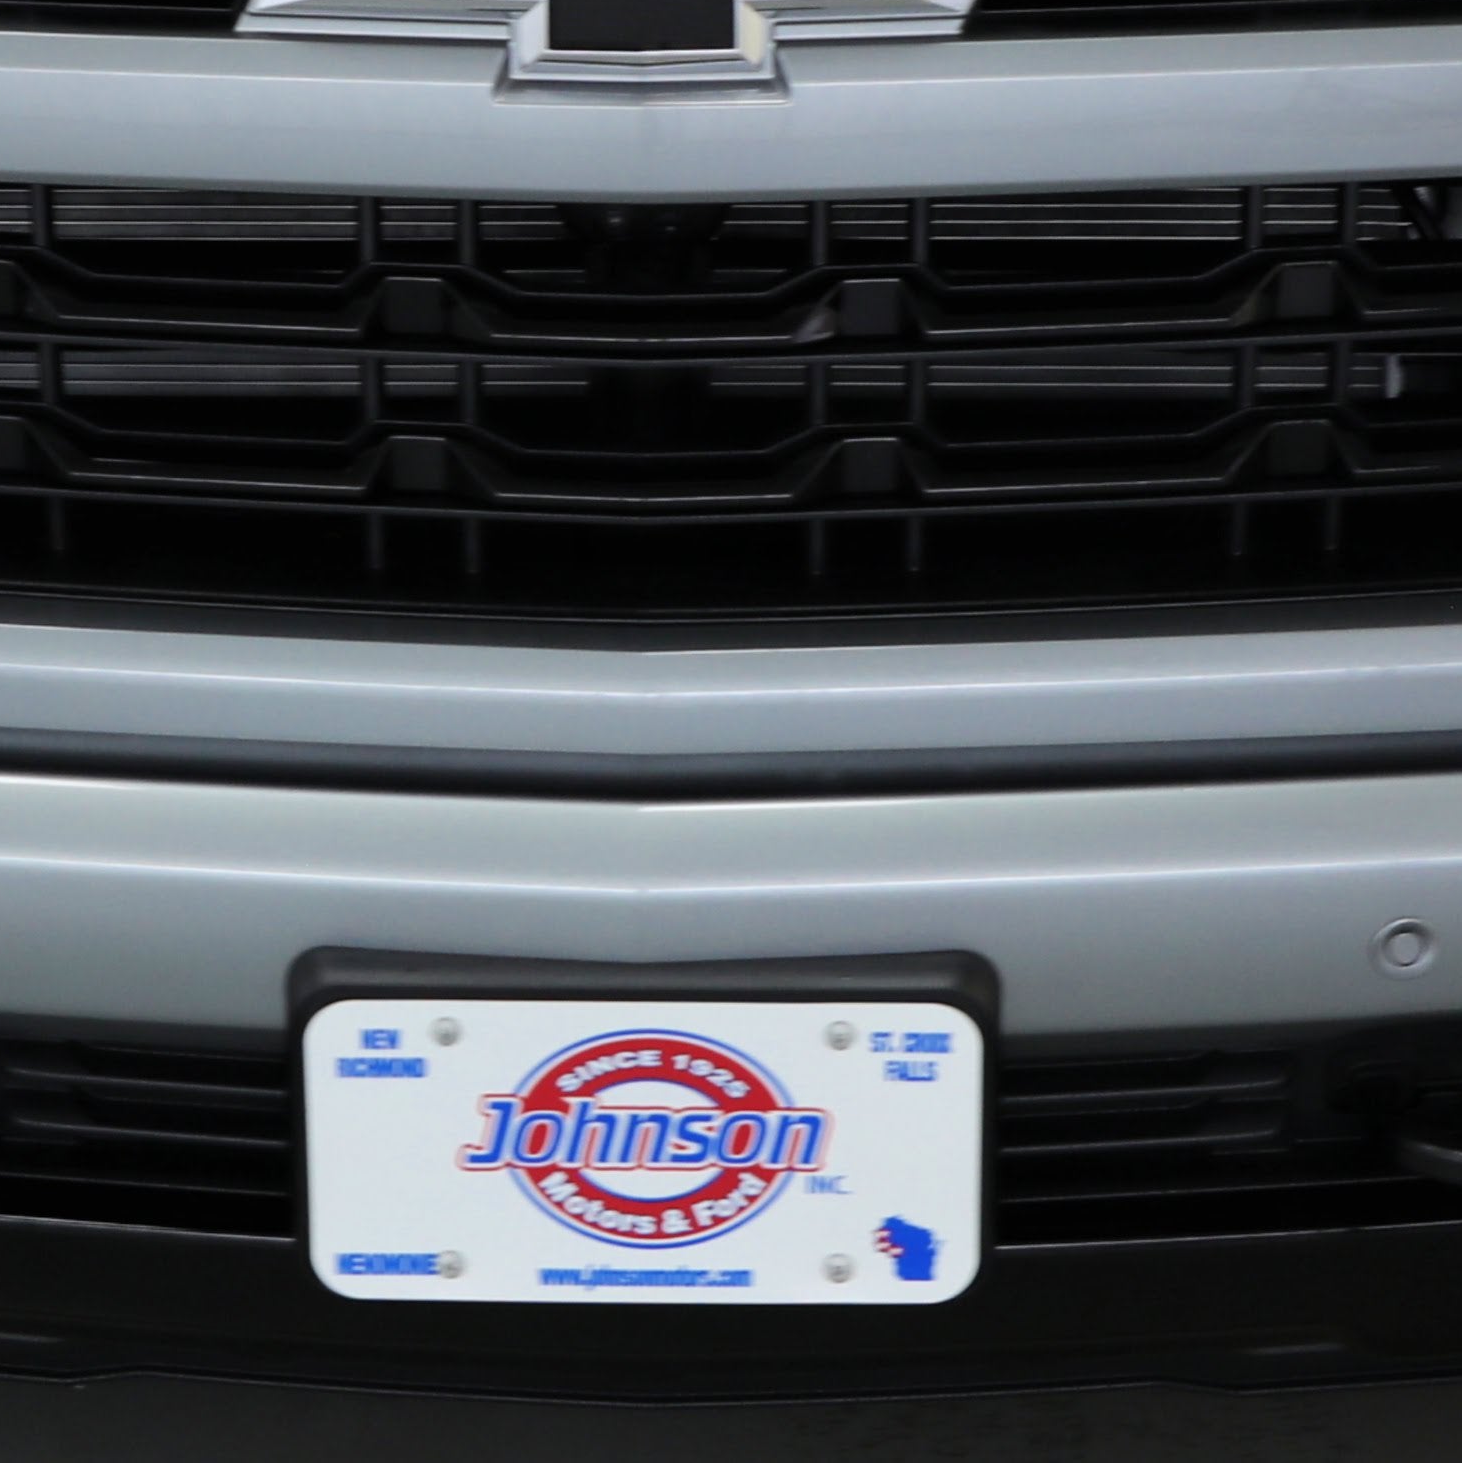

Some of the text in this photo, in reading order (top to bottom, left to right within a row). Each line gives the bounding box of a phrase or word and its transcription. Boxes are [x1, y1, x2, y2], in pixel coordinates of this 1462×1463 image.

[556, 1050, 751, 1098] SINCE 1925
[464, 1099, 825, 1167] Johnson
[539, 1172, 768, 1235] Motors & Ford
